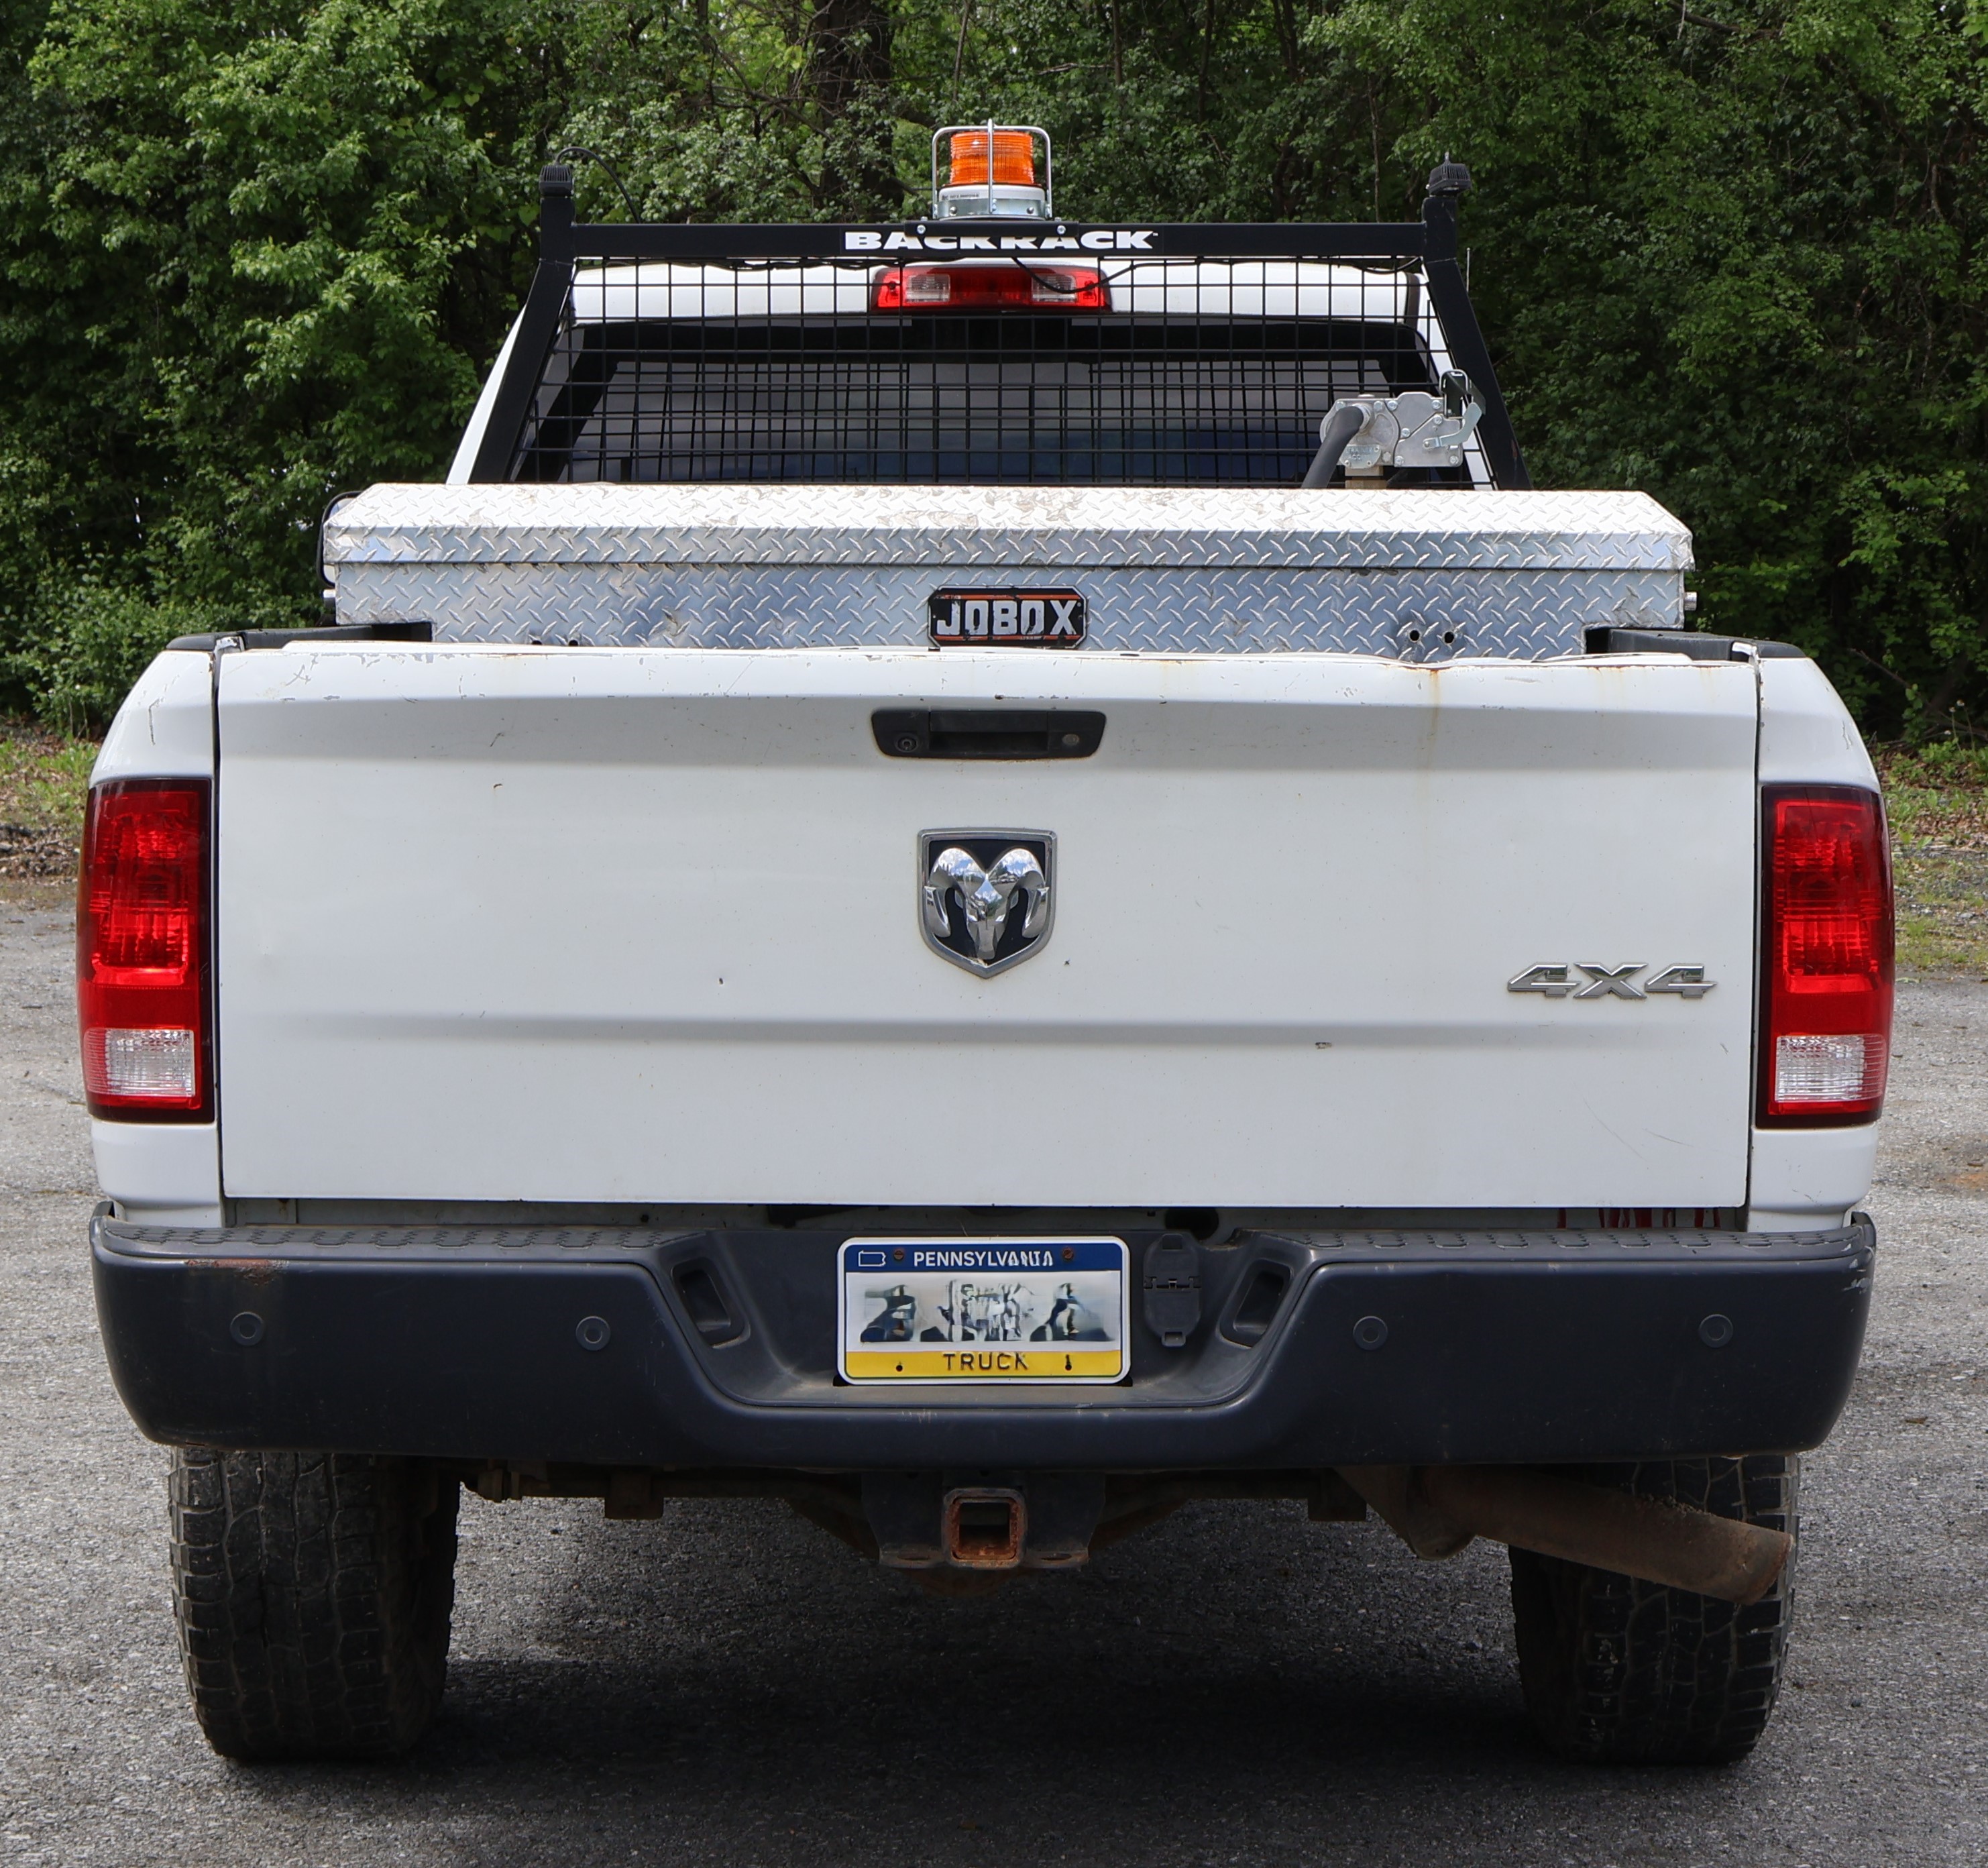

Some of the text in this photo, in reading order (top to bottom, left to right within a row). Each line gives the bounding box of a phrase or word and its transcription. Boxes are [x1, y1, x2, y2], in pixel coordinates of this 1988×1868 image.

[845, 231, 1154, 250] BACKRACK
[936, 600, 1077, 635] JOBOX
[1507, 963, 1718, 999] 4X4
[914, 1251, 1054, 1266] PENNSYLVANIA
[942, 1352, 1029, 1371] TRUCK
